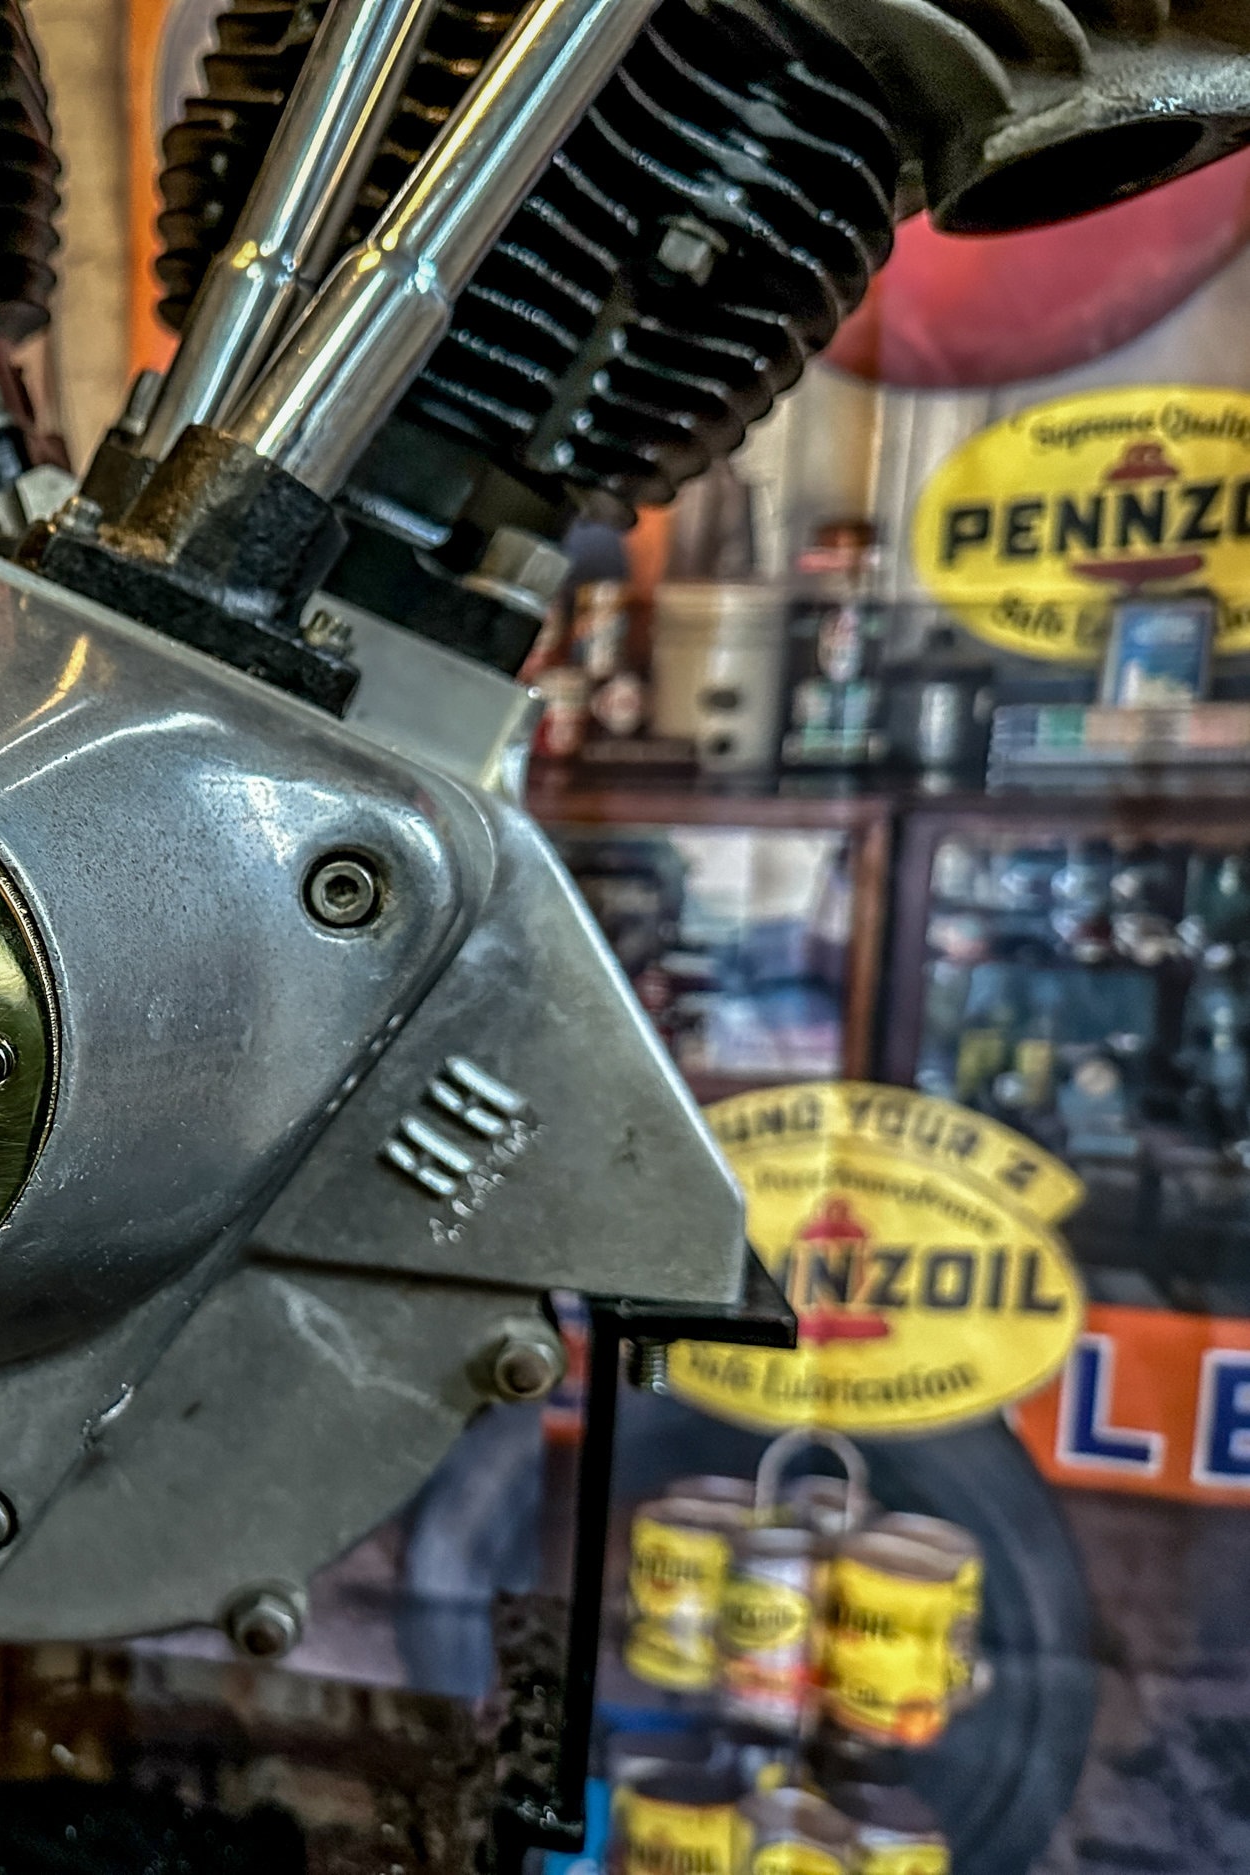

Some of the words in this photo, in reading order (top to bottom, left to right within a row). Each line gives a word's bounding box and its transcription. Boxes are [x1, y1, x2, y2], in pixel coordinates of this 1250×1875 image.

[1031, 413, 1153, 452] Supreme
[716, 1093, 823, 1143] UND
[776, 1243, 1064, 1315] NZOIL
